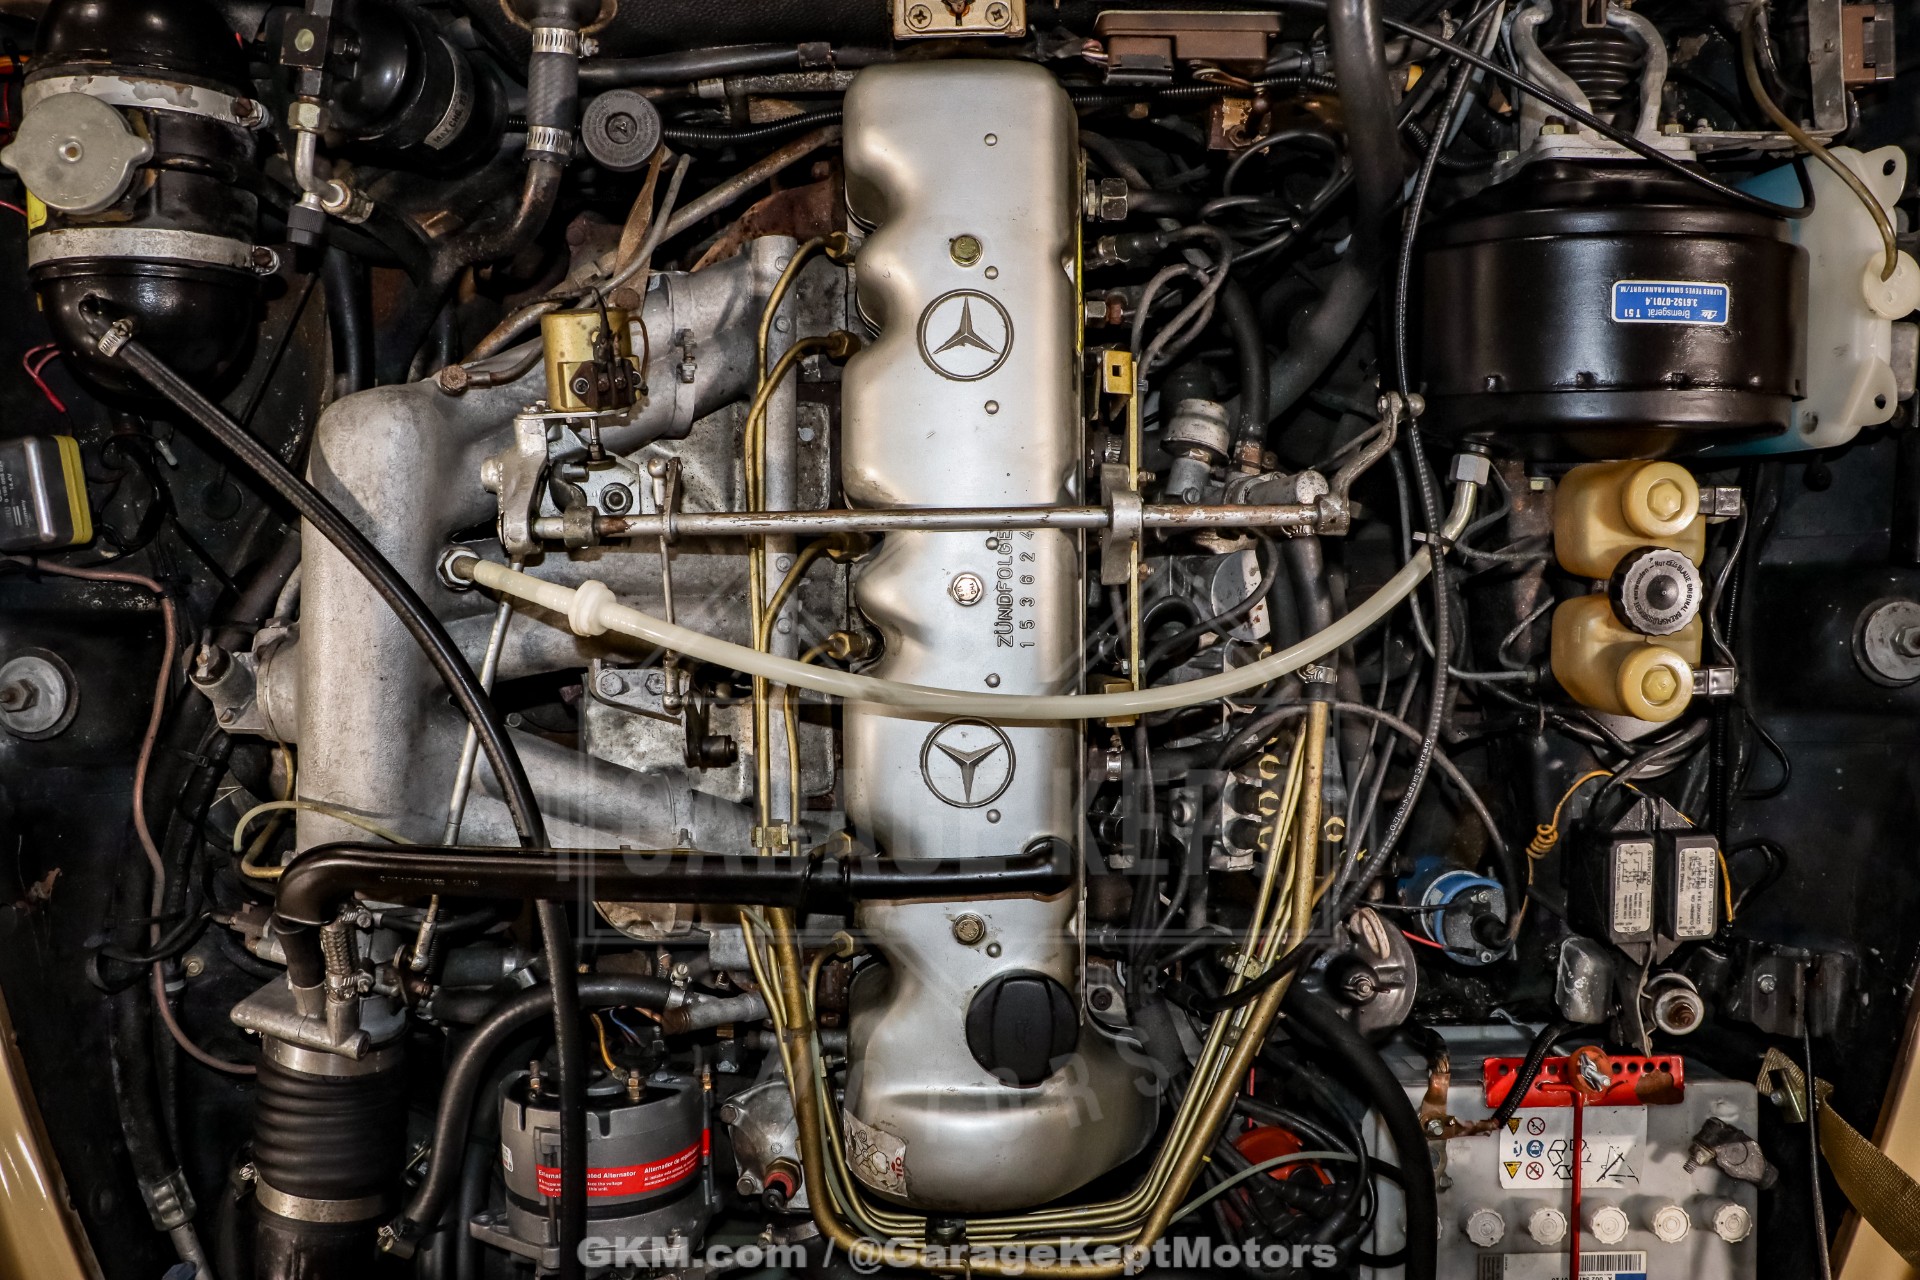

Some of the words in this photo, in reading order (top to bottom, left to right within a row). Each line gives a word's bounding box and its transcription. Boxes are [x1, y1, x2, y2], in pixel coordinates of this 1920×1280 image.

[1645, 297, 1698, 307] 3.6152-0701.4
[1648, 308, 1690, 319] Bremsgerät
[1019, 531, 1035, 540] 4
[1019, 552, 1035, 562] 2
[1019, 575, 1035, 585] 6
[994, 531, 1014, 648] ZÜNDFOLGE
[1019, 597, 1035, 607] 3
[1019, 620, 1035, 629] 5
